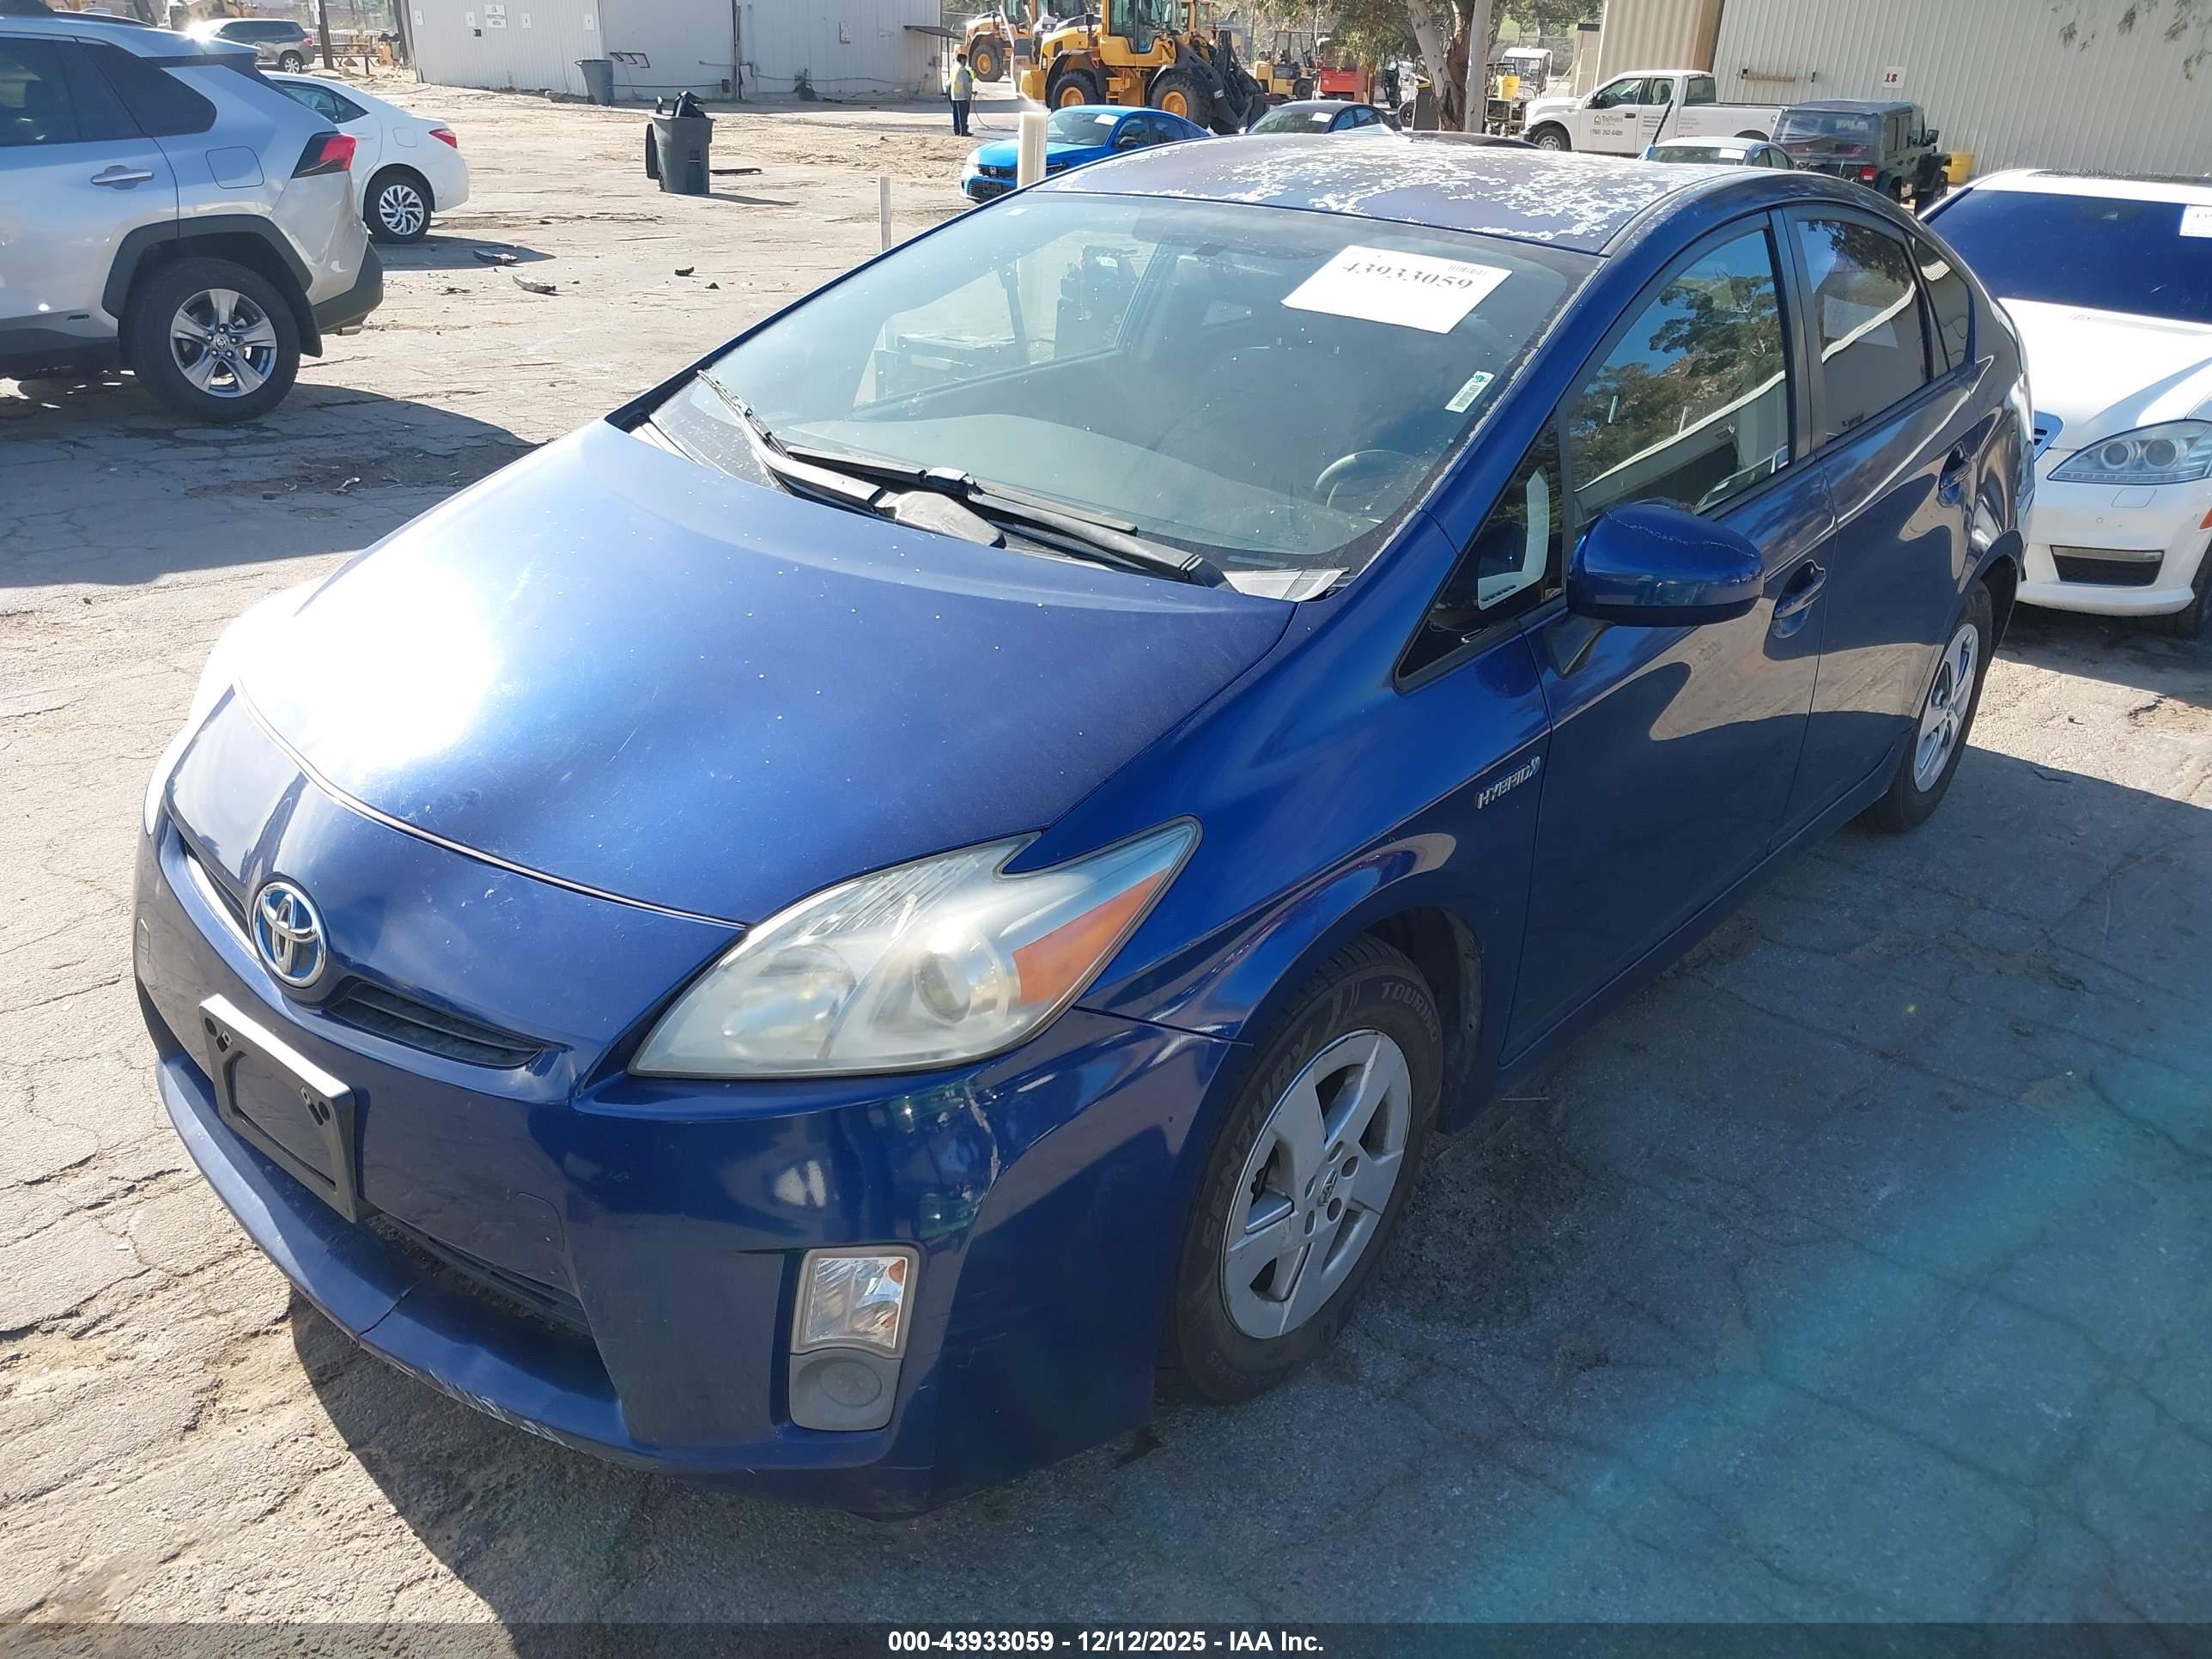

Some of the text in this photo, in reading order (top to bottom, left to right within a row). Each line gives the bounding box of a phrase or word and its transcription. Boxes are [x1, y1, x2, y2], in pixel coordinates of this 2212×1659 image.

[1883, 72, 1898, 83] 18
[1342, 261, 1474, 289] 43933059
[1476, 764, 1534, 810] HYBRID
